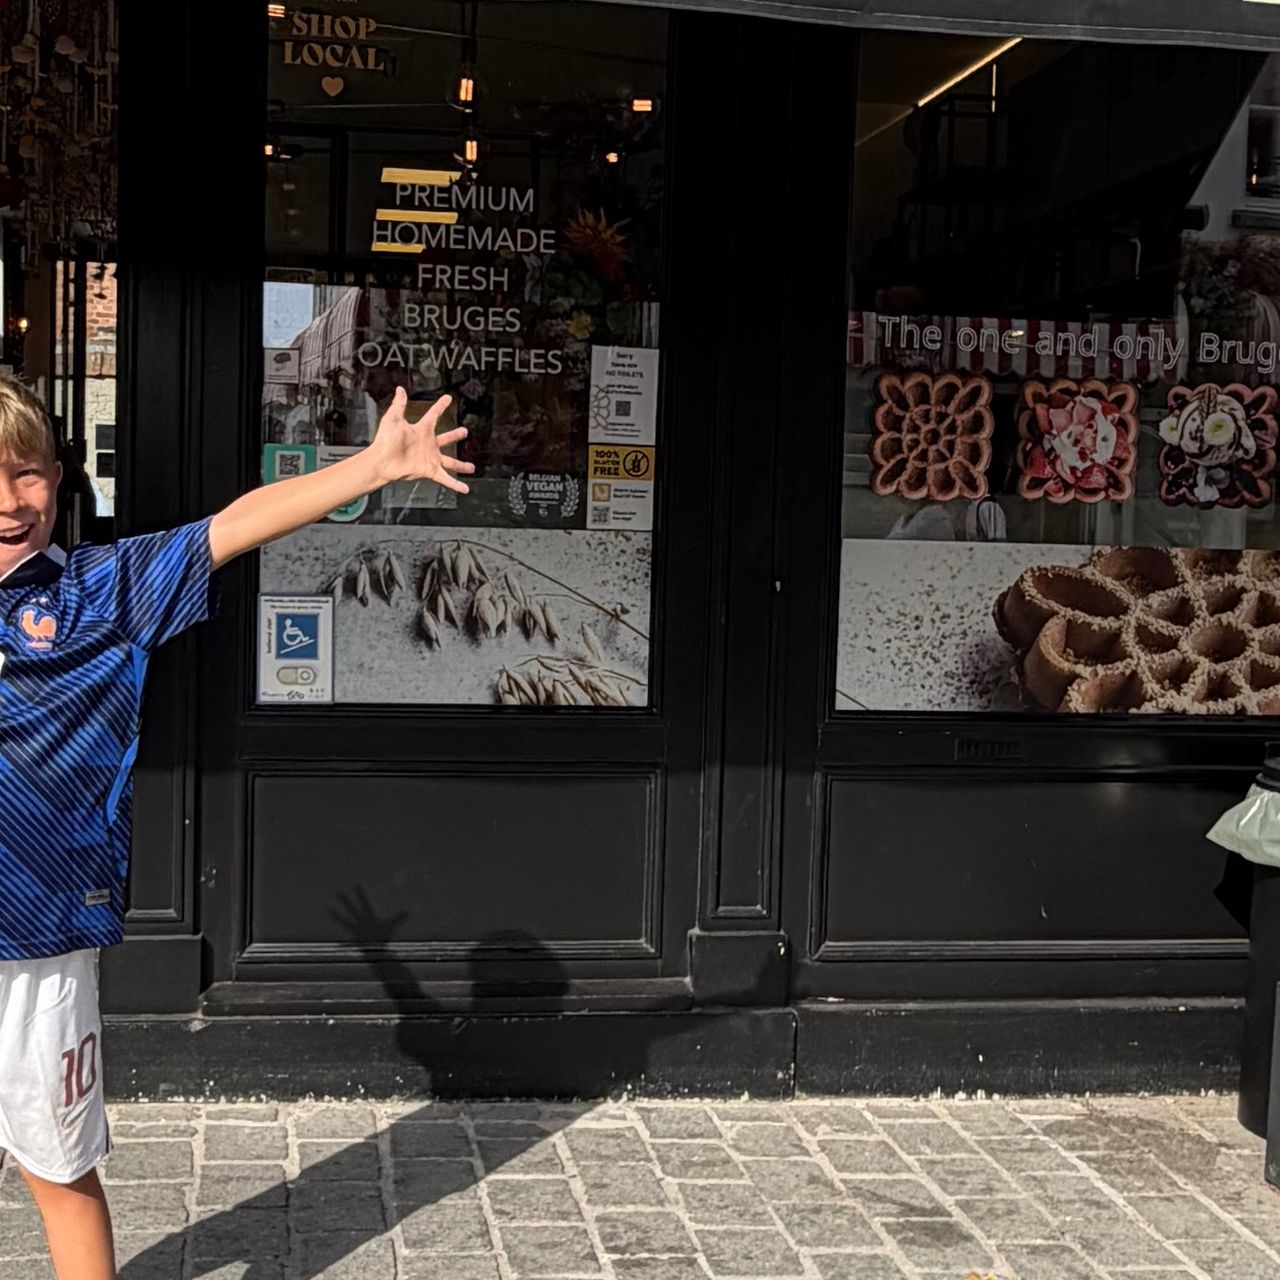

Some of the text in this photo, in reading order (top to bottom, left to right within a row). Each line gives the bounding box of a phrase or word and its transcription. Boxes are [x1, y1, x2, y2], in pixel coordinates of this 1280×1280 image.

[291, 11, 377, 41] SHOP
[283, 41, 384, 71] LOCAL
[395, 183, 534, 212] PREMIUM
[372, 221, 556, 254] HOMEMADE
[418, 264, 509, 292] FRESH
[404, 304, 521, 333] BRUGES
[878, 315, 942, 350] The
[956, 323, 1021, 355] one
[1034, 324, 1099, 358] and
[1113, 326, 1185, 369] only
[358, 341, 562, 375] OAT WAFFLES
[593, 467, 620, 476] FREE
[526, 482, 564, 492] VEGAN
[61, 1031, 97, 1108] 10
